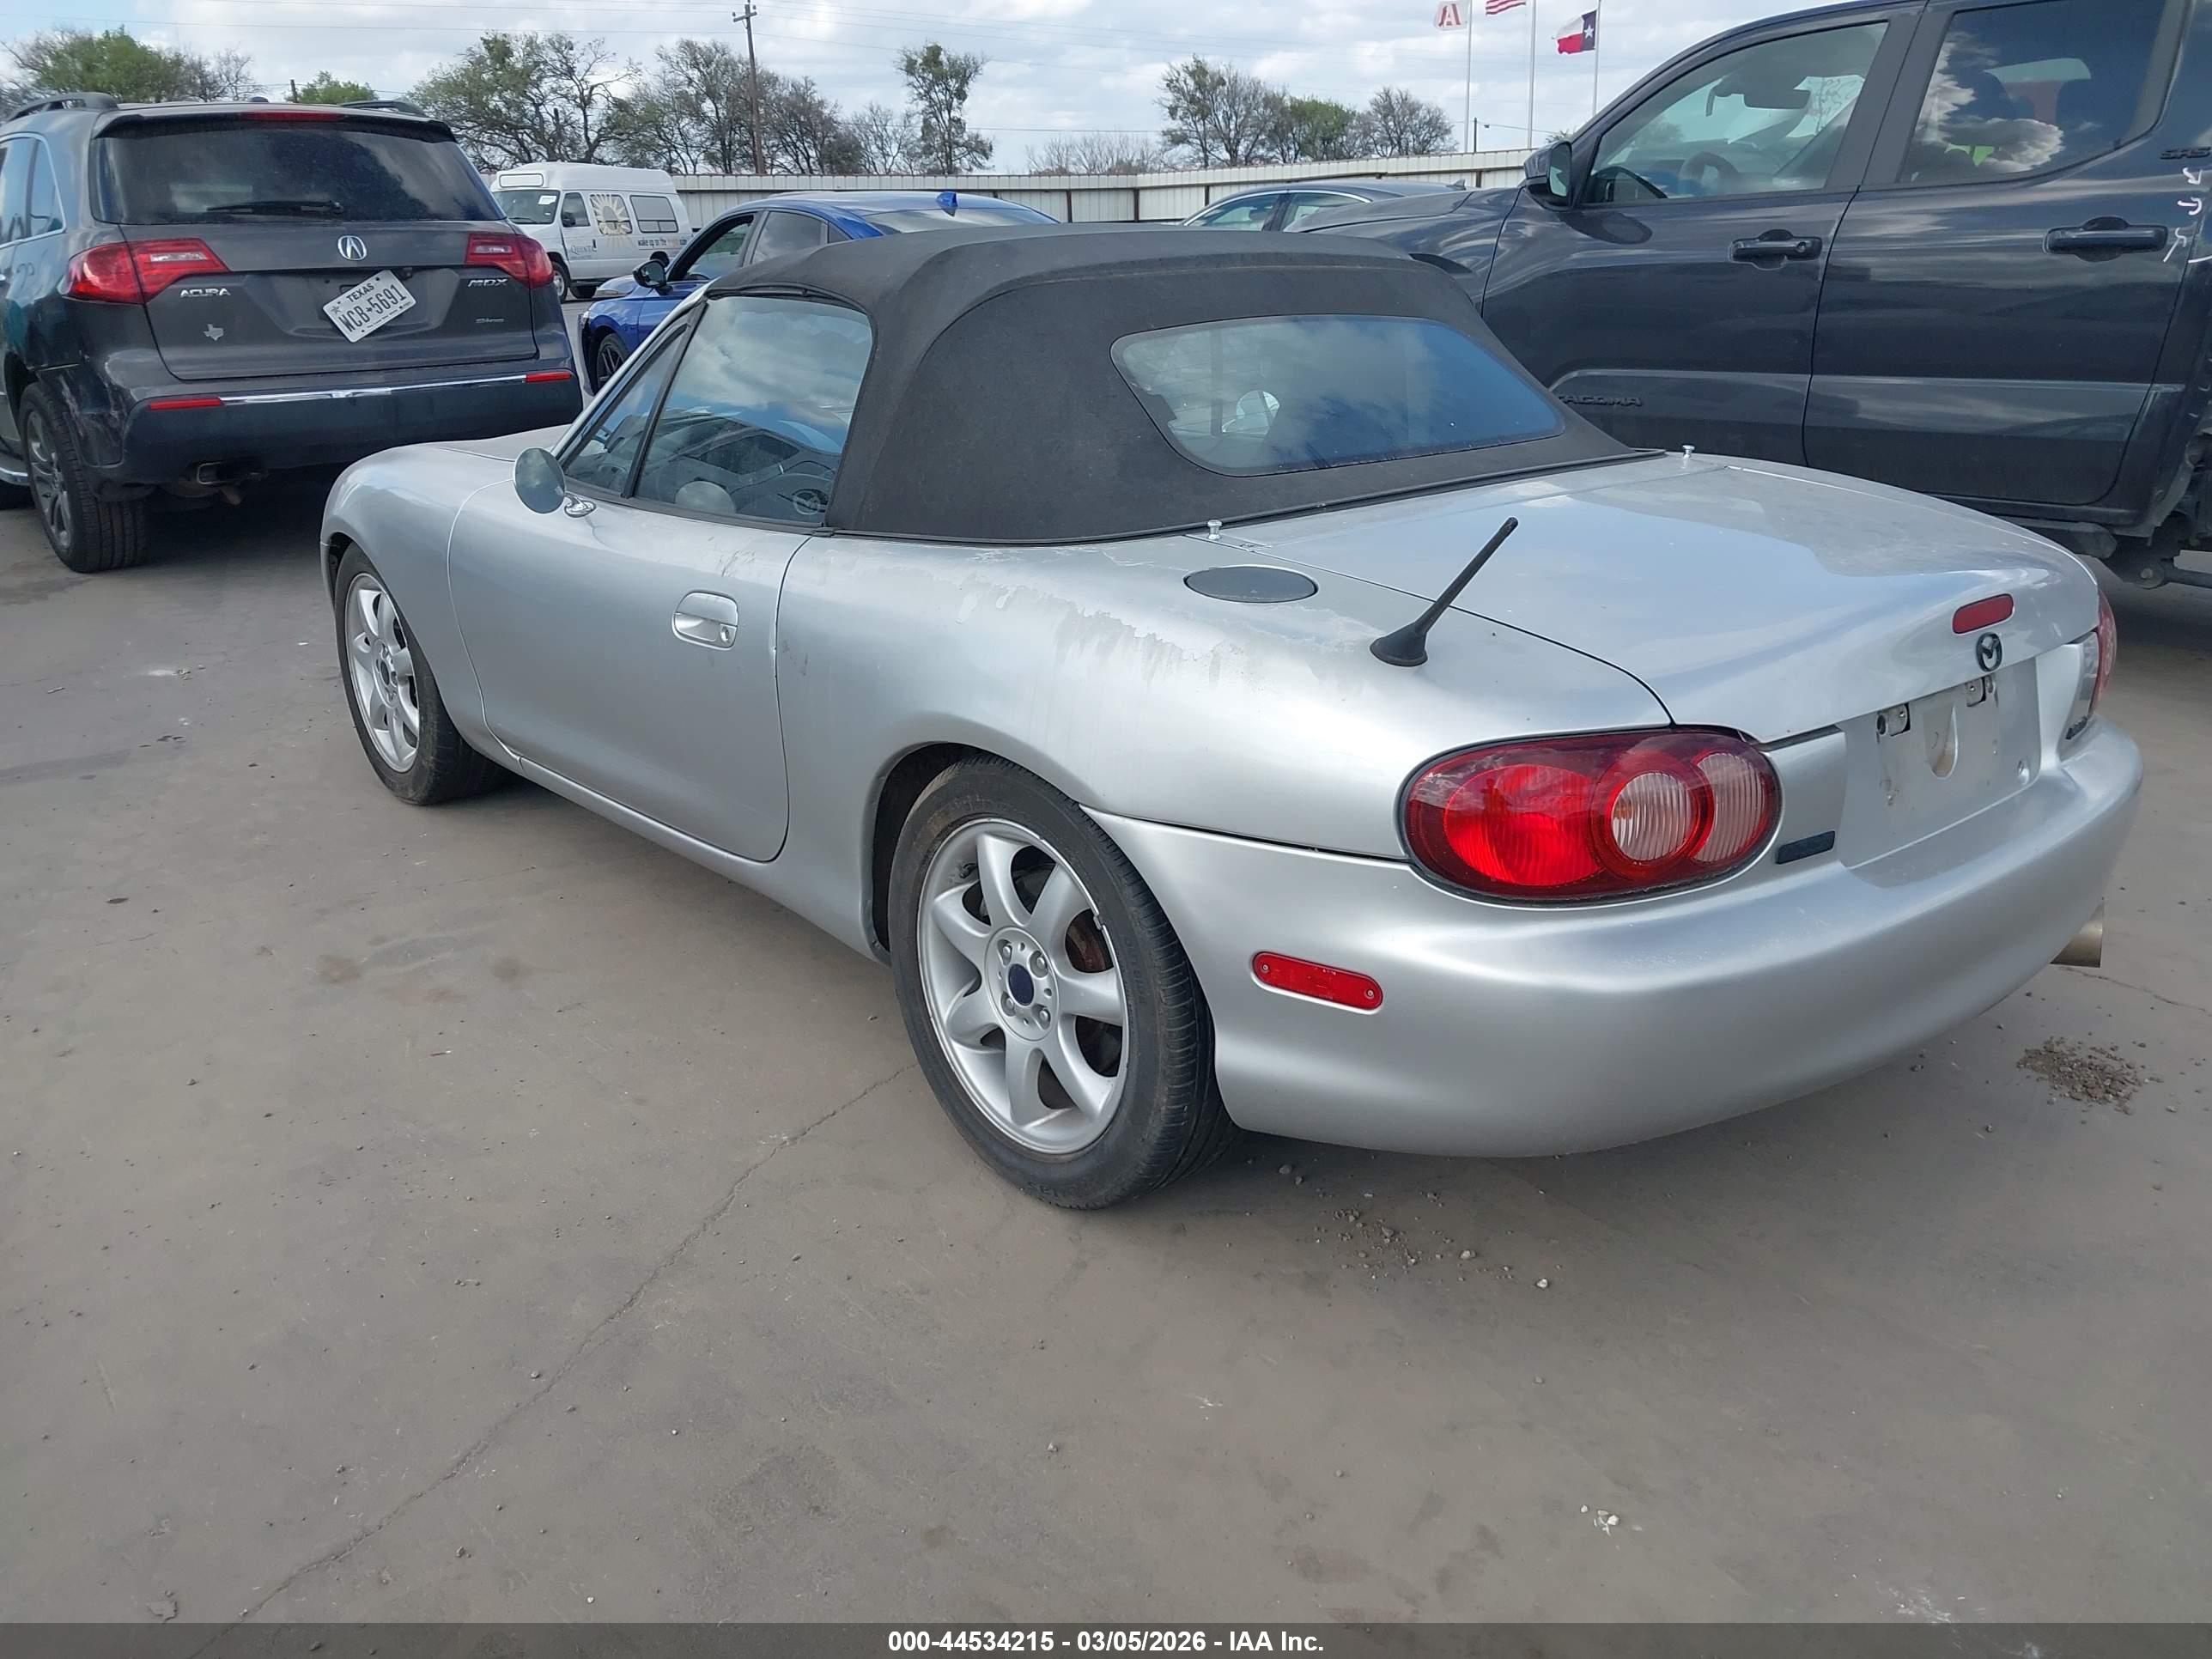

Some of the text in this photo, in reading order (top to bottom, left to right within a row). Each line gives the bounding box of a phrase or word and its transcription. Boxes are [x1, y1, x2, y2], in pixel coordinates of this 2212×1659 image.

[467, 278, 508, 288] MDX
[179, 288, 232, 298] ACURA
[346, 283, 374, 302] TEXAS
